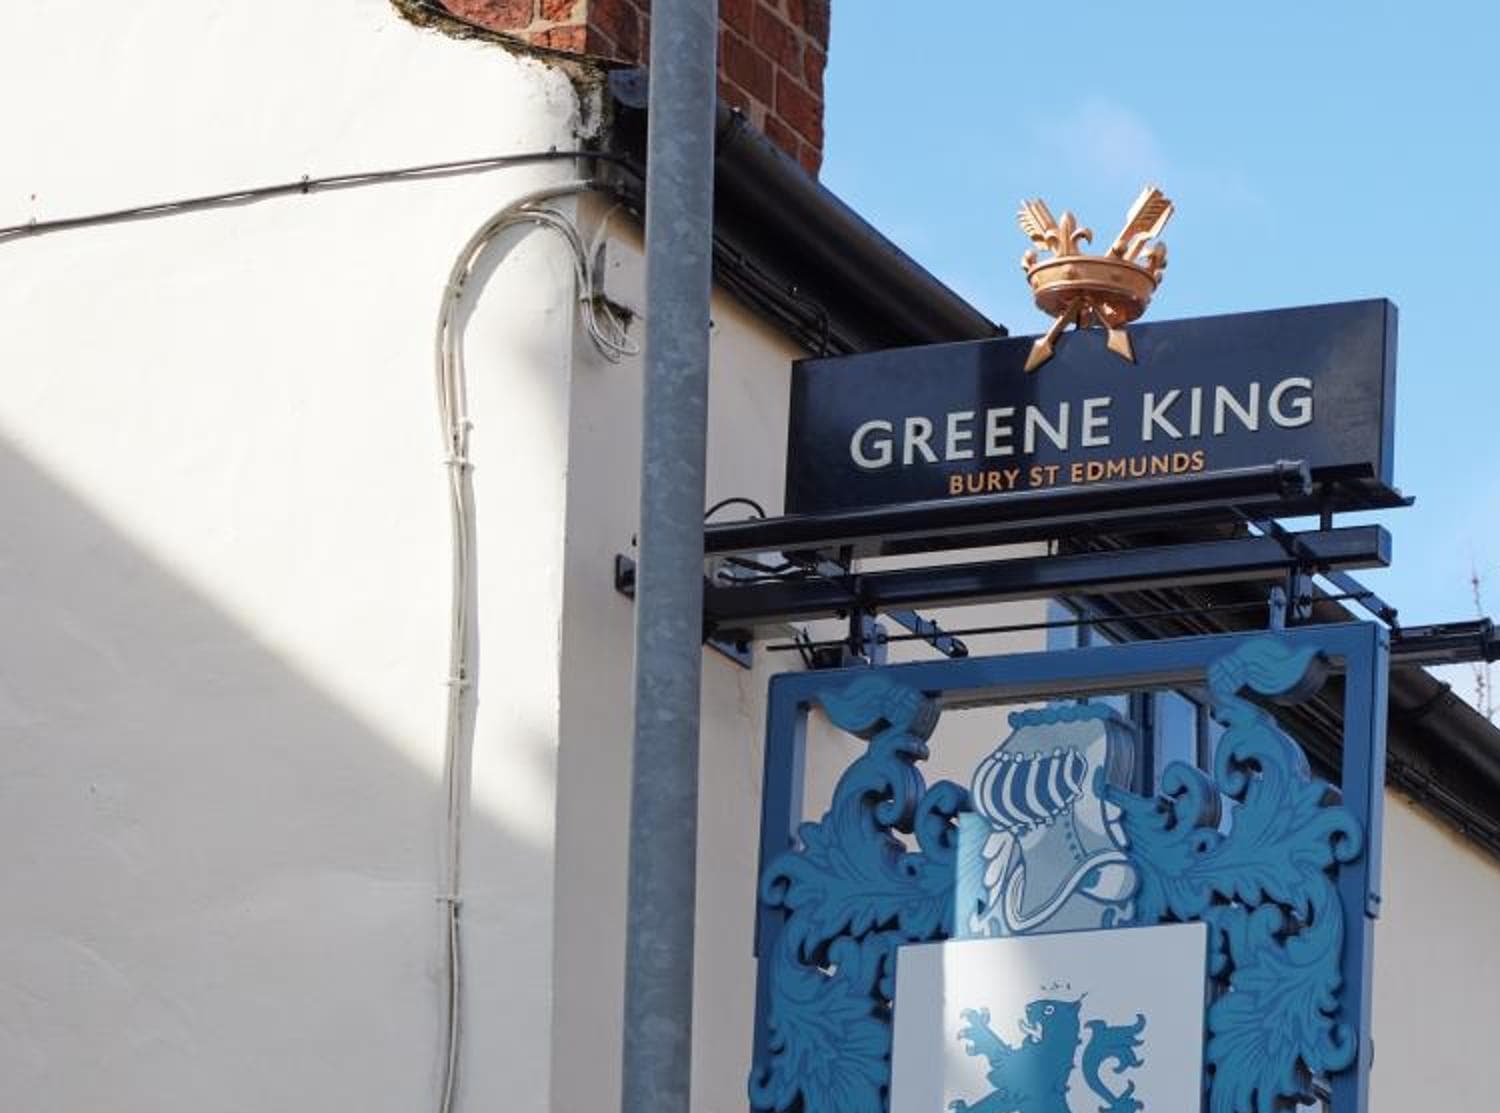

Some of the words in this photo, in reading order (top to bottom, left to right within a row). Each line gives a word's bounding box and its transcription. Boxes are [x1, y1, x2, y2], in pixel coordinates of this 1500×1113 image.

[849, 396, 1111, 469] GREENE
[1141, 376, 1315, 442] KING
[948, 469, 1020, 496] BURY
[1030, 465, 1058, 488] ST
[1071, 450, 1205, 484] EDMUNDS
